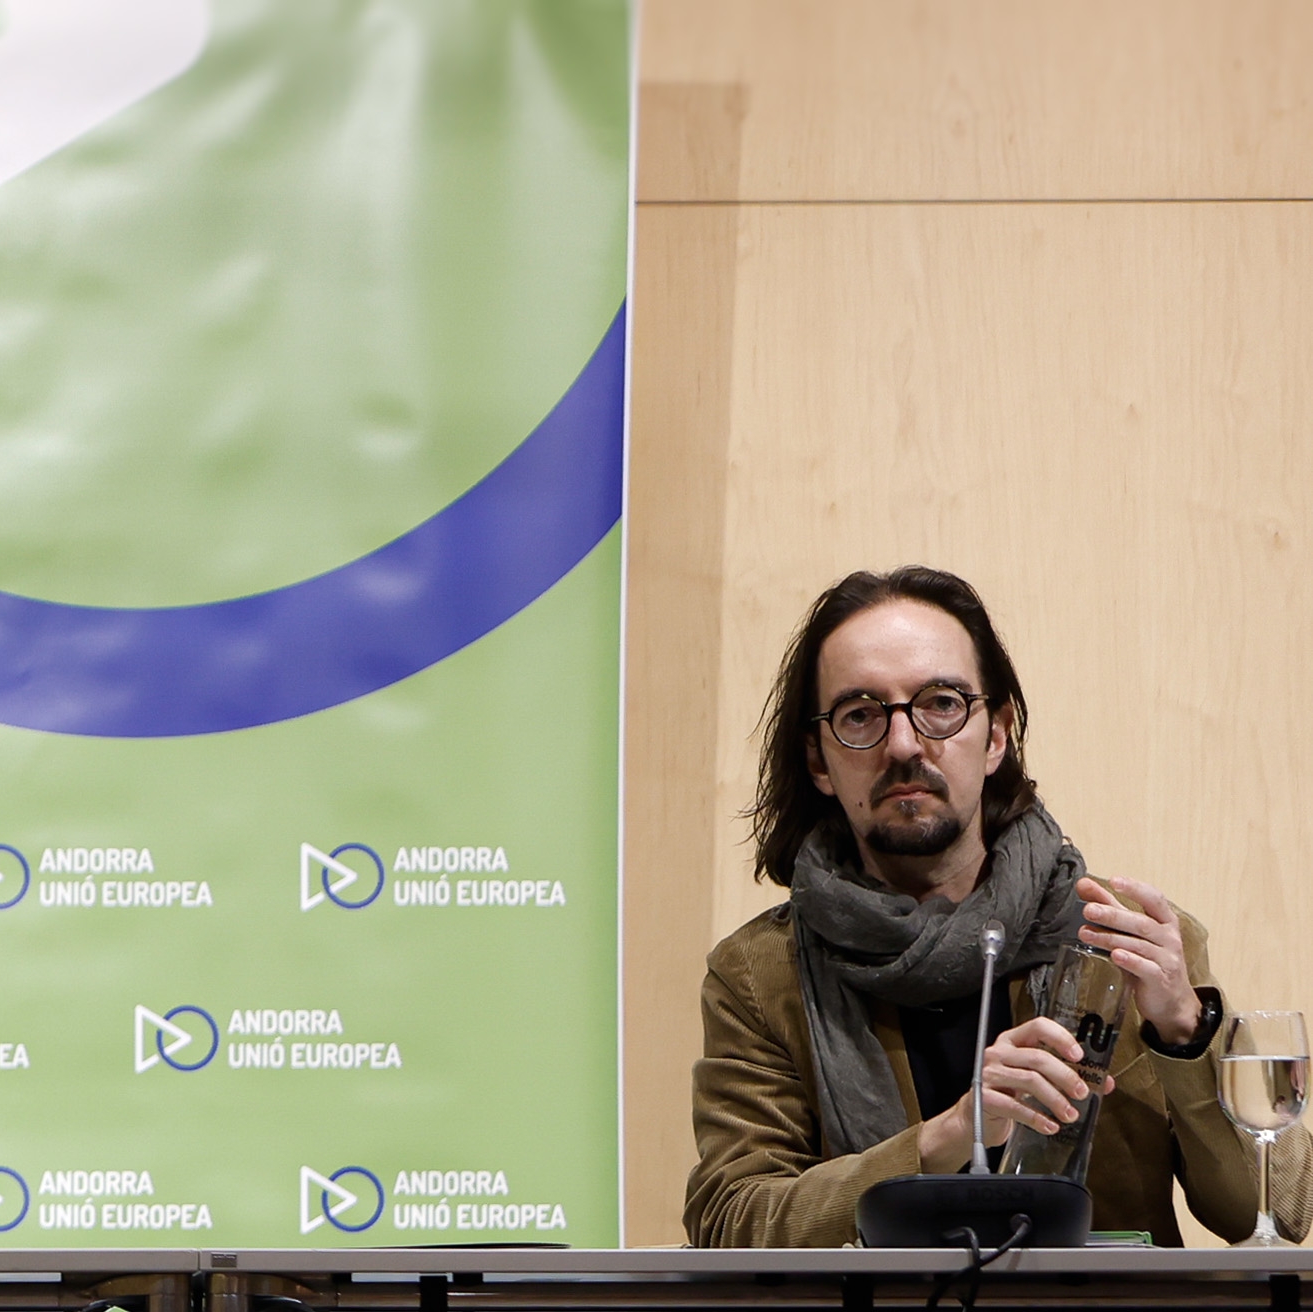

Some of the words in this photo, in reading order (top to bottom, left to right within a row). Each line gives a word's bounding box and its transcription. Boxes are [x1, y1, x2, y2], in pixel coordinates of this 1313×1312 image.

[39, 848, 154, 873] ANDORRA
[393, 847, 509, 872] ANDORRA
[39, 875, 97, 907] UNIÓ
[102, 881, 213, 907] EUROPEA
[393, 874, 451, 906] UNIÓ
[456, 880, 567, 906] EUROPEA
[228, 1009, 343, 1034] ANDORRA
[228, 1037, 286, 1068] UNIÓ
[291, 1043, 402, 1068] EUROPEA
[39, 1171, 154, 1195] ANDORRA
[393, 1171, 509, 1195] ANDORRA
[39, 1198, 97, 1229] UNIÓ
[102, 1204, 213, 1229] EUROPEA
[393, 1197, 451, 1229] UNIÓ
[456, 1204, 568, 1230] EUROPEA
